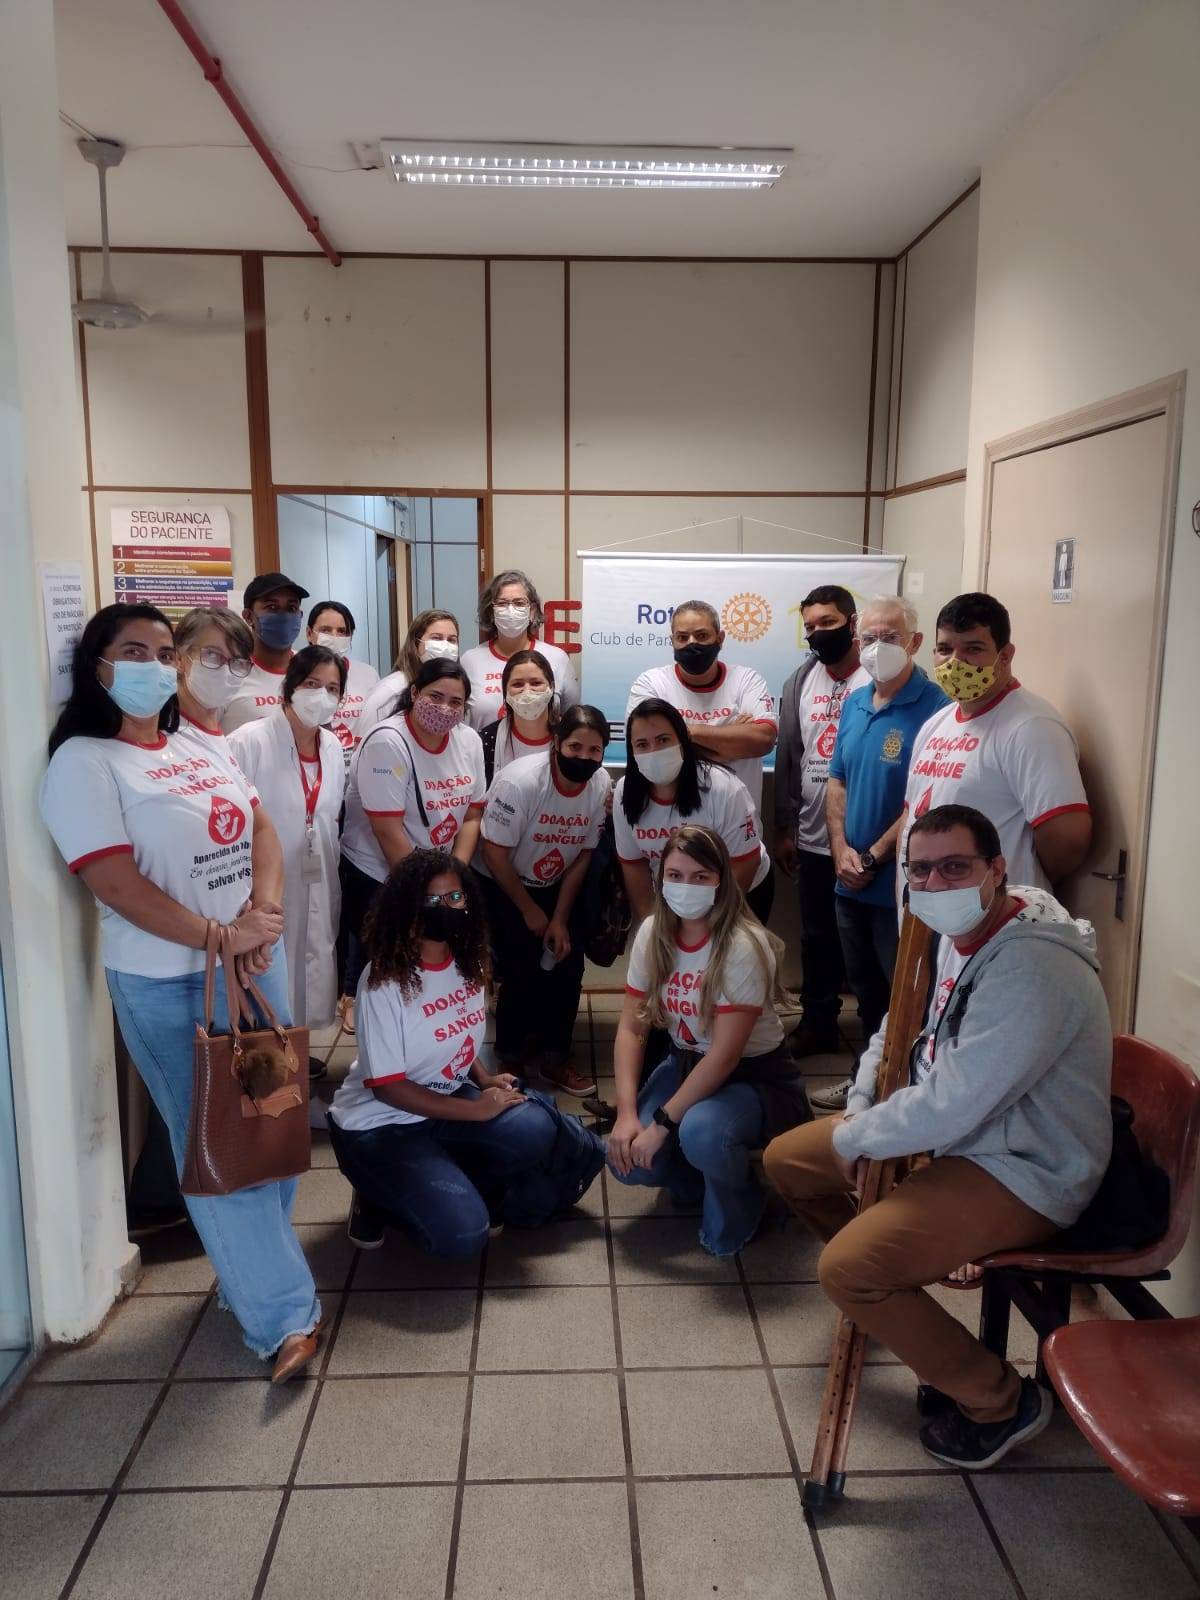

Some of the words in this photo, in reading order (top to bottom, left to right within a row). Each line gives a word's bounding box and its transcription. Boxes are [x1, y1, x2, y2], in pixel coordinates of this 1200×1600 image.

[130, 526, 148, 538] DO
[151, 526, 213, 540] PACIENTE
[117, 546, 123, 558] 1
[117, 561, 126, 574] 2
[118, 577, 127, 590] 3
[119, 593, 128, 604] 4
[637, 604, 674, 625] Rot
[590, 632, 621, 646] Club
[626, 633, 643, 646] de
[913, 760, 966, 779] SANGUE
[538, 813, 589, 829] DOAÇÃO
[456, 1007, 467, 1016] DE
[434, 1008, 486, 1042] SANGU
